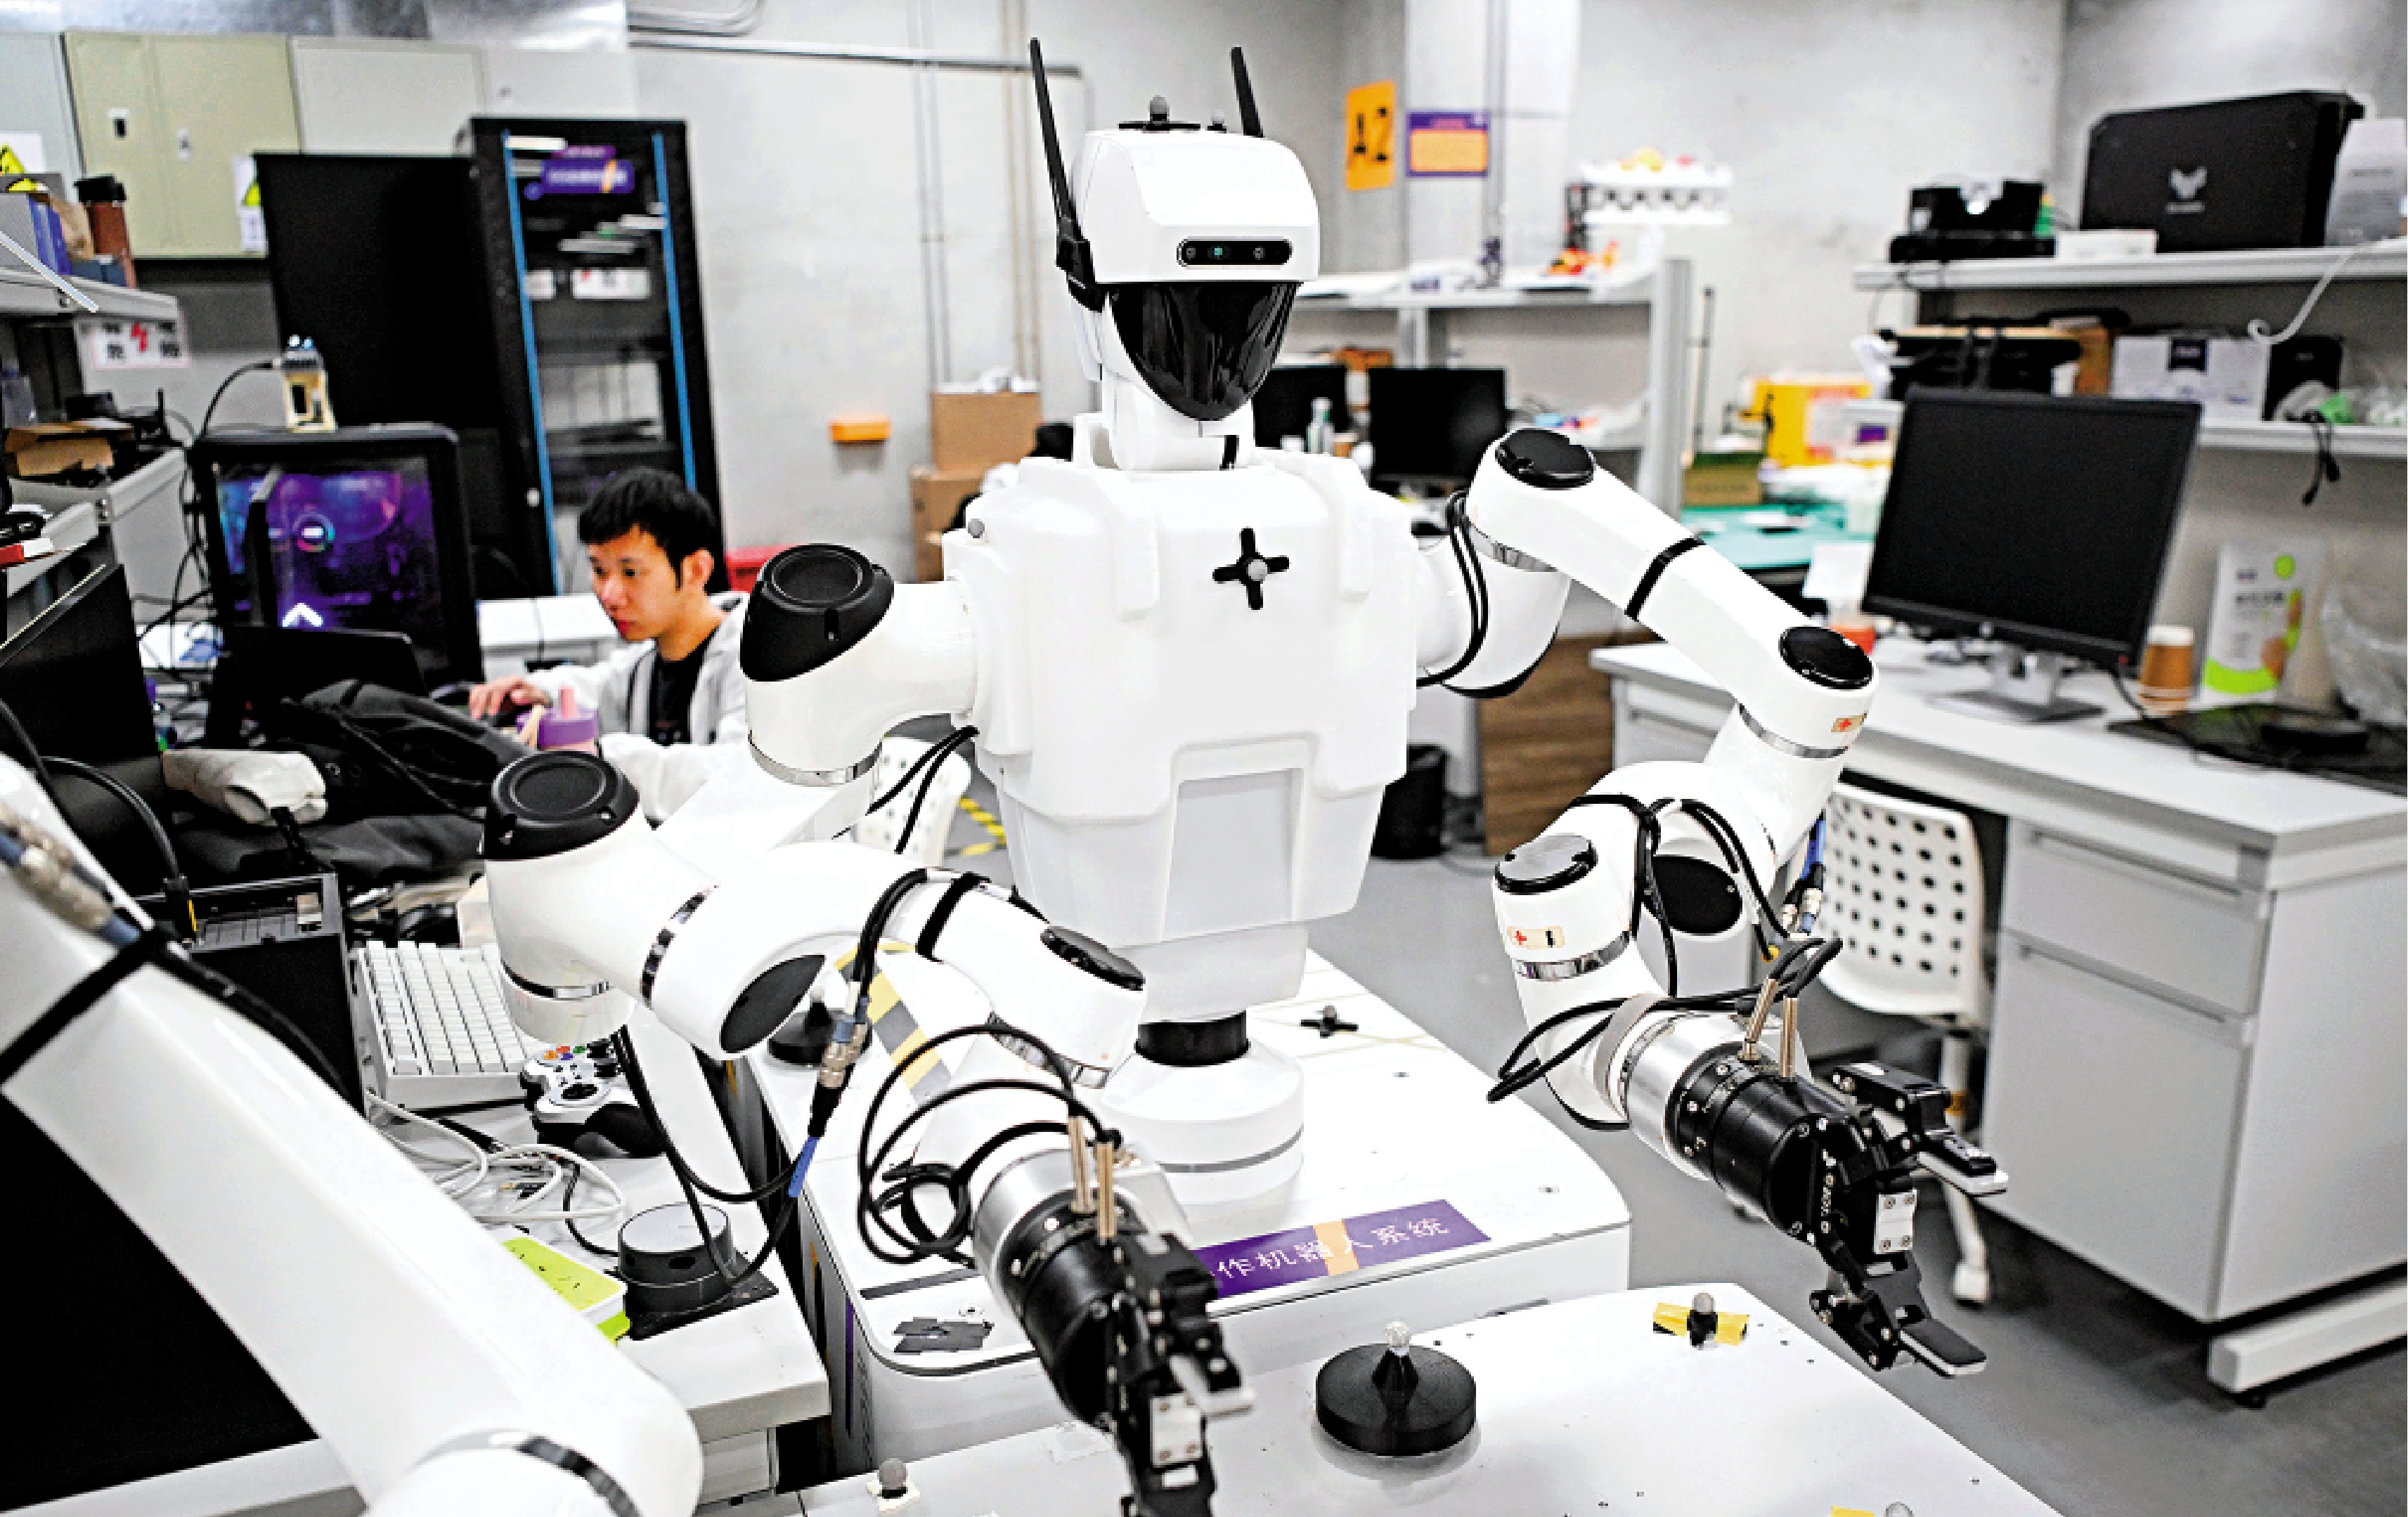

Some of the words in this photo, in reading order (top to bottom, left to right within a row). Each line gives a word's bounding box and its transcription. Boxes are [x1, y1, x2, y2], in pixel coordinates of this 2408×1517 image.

[1210, 1217, 1450, 1279] 作机器人系统
